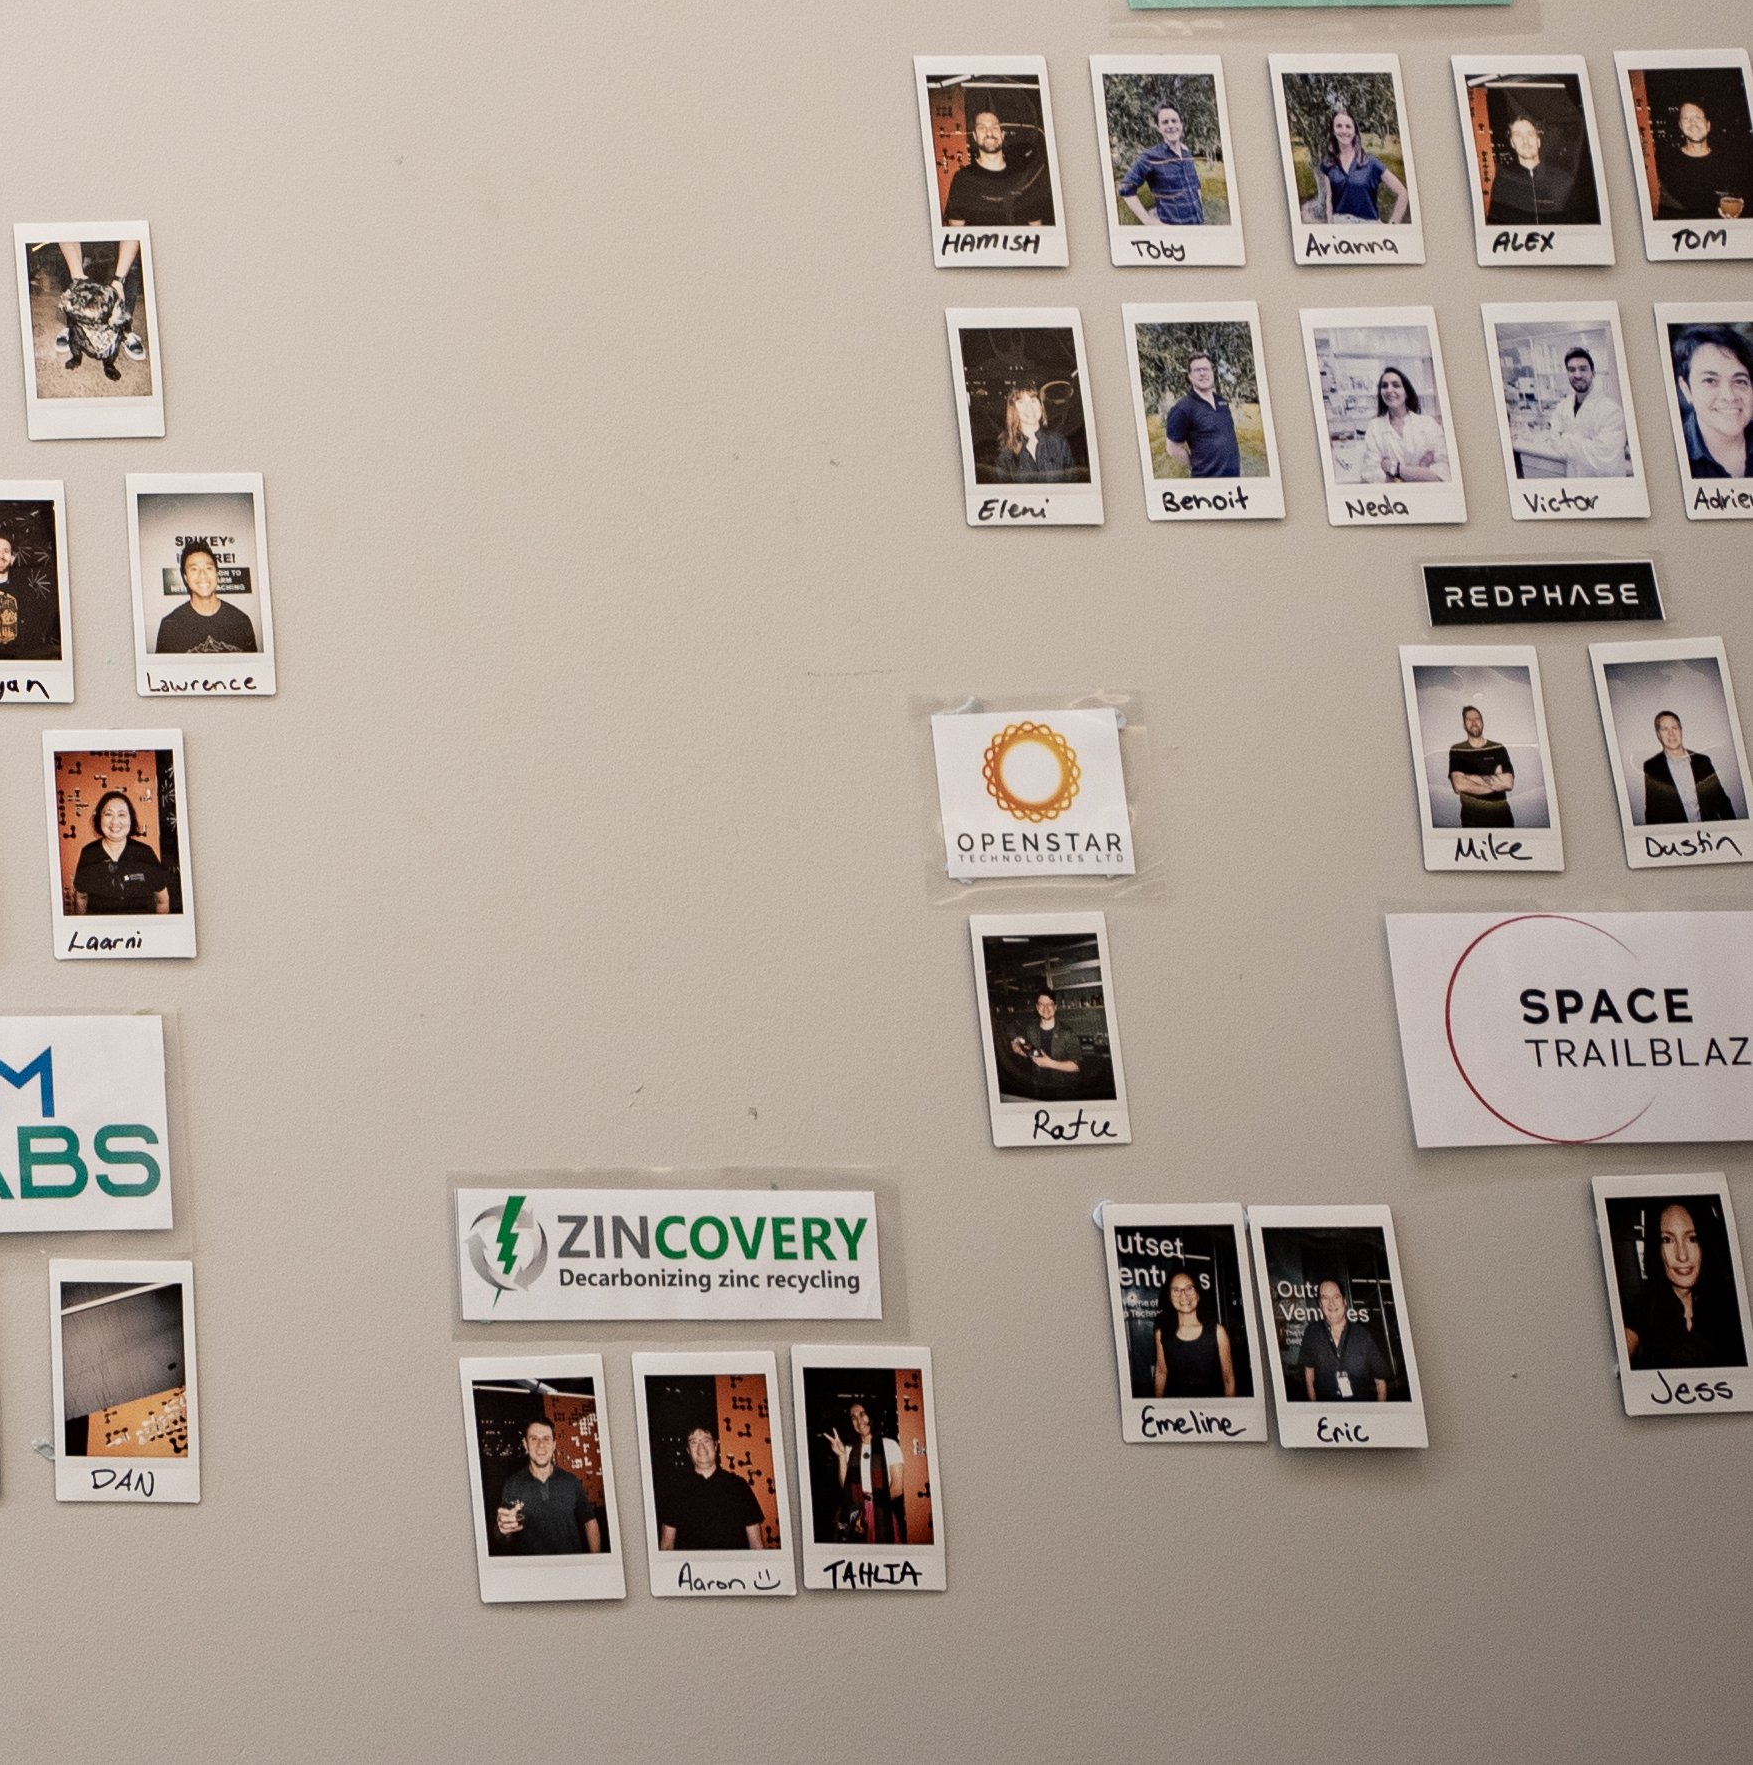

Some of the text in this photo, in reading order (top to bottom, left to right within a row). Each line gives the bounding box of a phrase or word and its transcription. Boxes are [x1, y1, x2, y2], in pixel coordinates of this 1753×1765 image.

[940, 232, 1041, 257] HAMISH
[1130, 239, 1186, 262] Toby
[1304, 234, 1399, 258] Arianna
[1491, 230, 1556, 254] ALEX
[1671, 230, 1728, 252] TOM
[1162, 489, 1250, 514] Benoit
[1524, 491, 1599, 514] Victor
[1444, 583, 1640, 608] REDPHASE
[147, 670, 258, 693] Lawrence
[956, 831, 1123, 855] OPENSTAR
[1453, 837, 1533, 863] Mike
[957, 852, 1126, 865] TECHNOLOGIES LTD
[1518, 987, 1694, 1026] SPACE
[556, 1214, 869, 1263] ZINCOVERY
[558, 1268, 861, 1294] Decarbonizing zinc recycling
[1651, 1371, 1734, 1406] Jess
[1141, 1404, 1247, 1440] Emeline
[91, 1468, 156, 1497] DAN
[823, 1559, 923, 1590] TAHLIA
